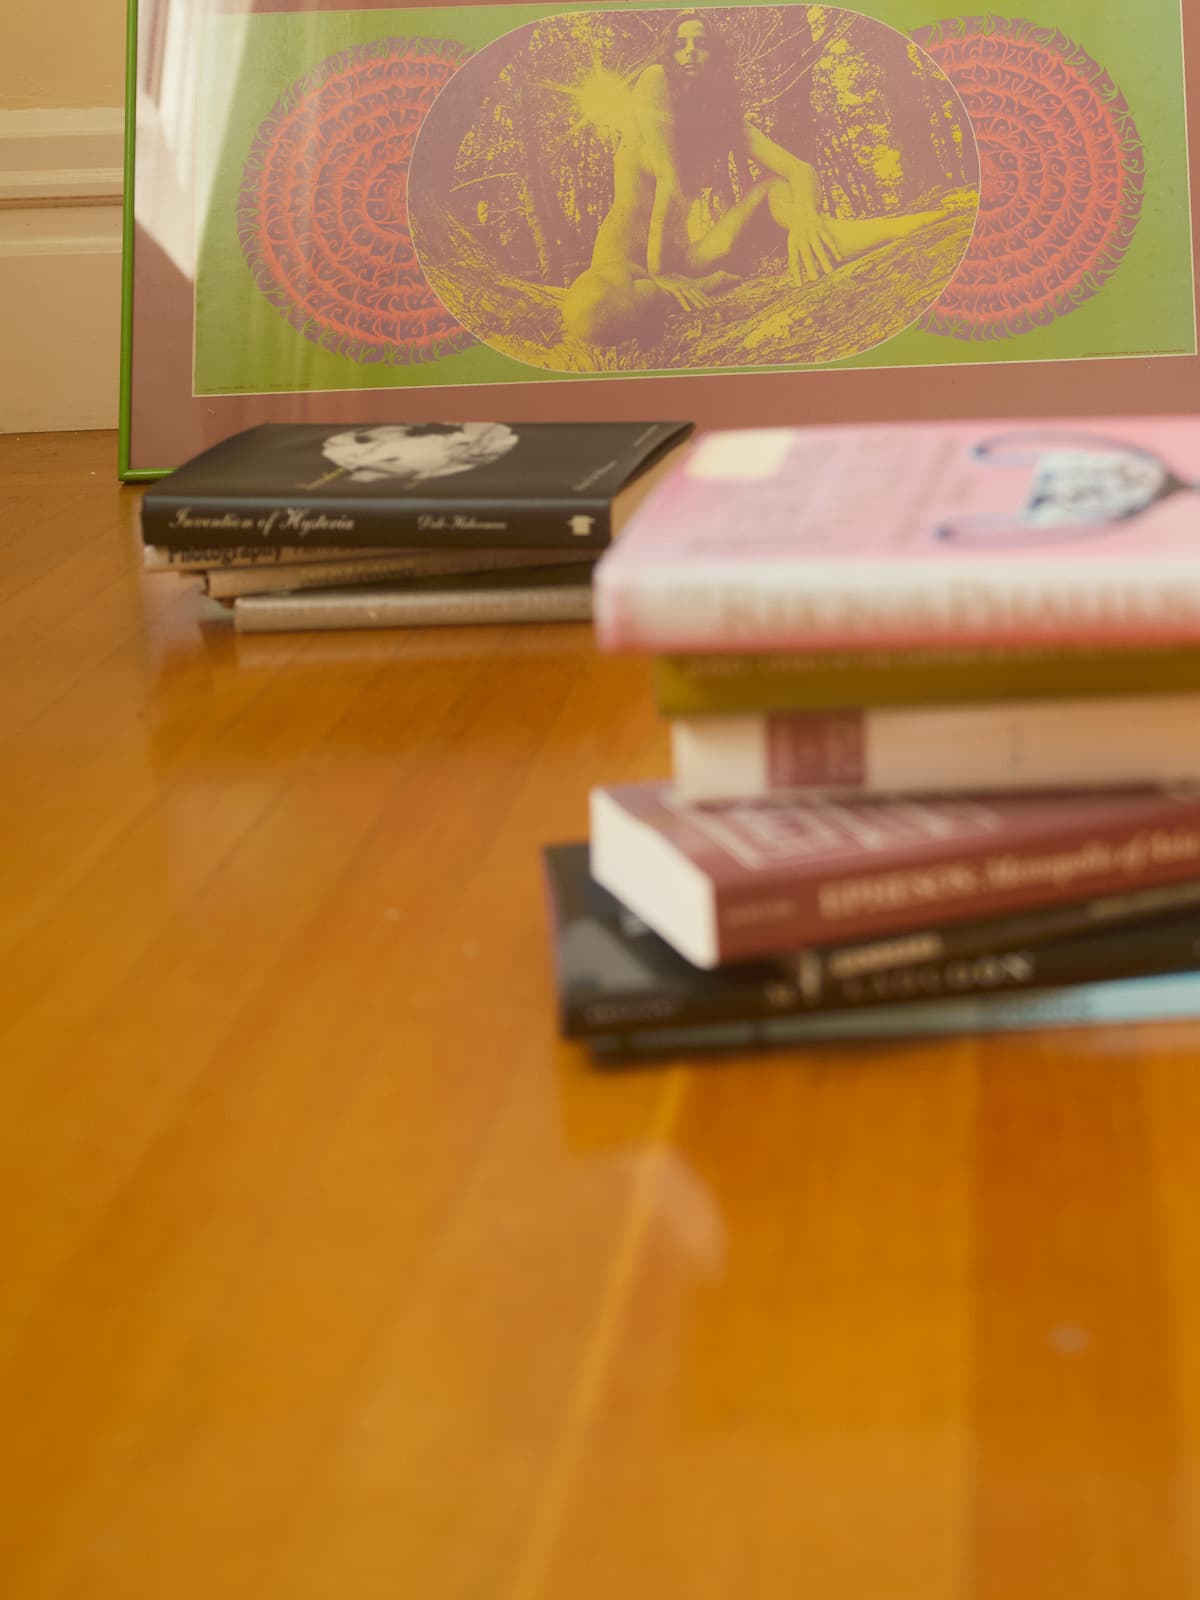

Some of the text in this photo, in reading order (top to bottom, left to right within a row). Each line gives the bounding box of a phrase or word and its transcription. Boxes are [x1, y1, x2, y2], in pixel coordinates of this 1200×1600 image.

[168, 506, 355, 538] Invention of Hysteria
